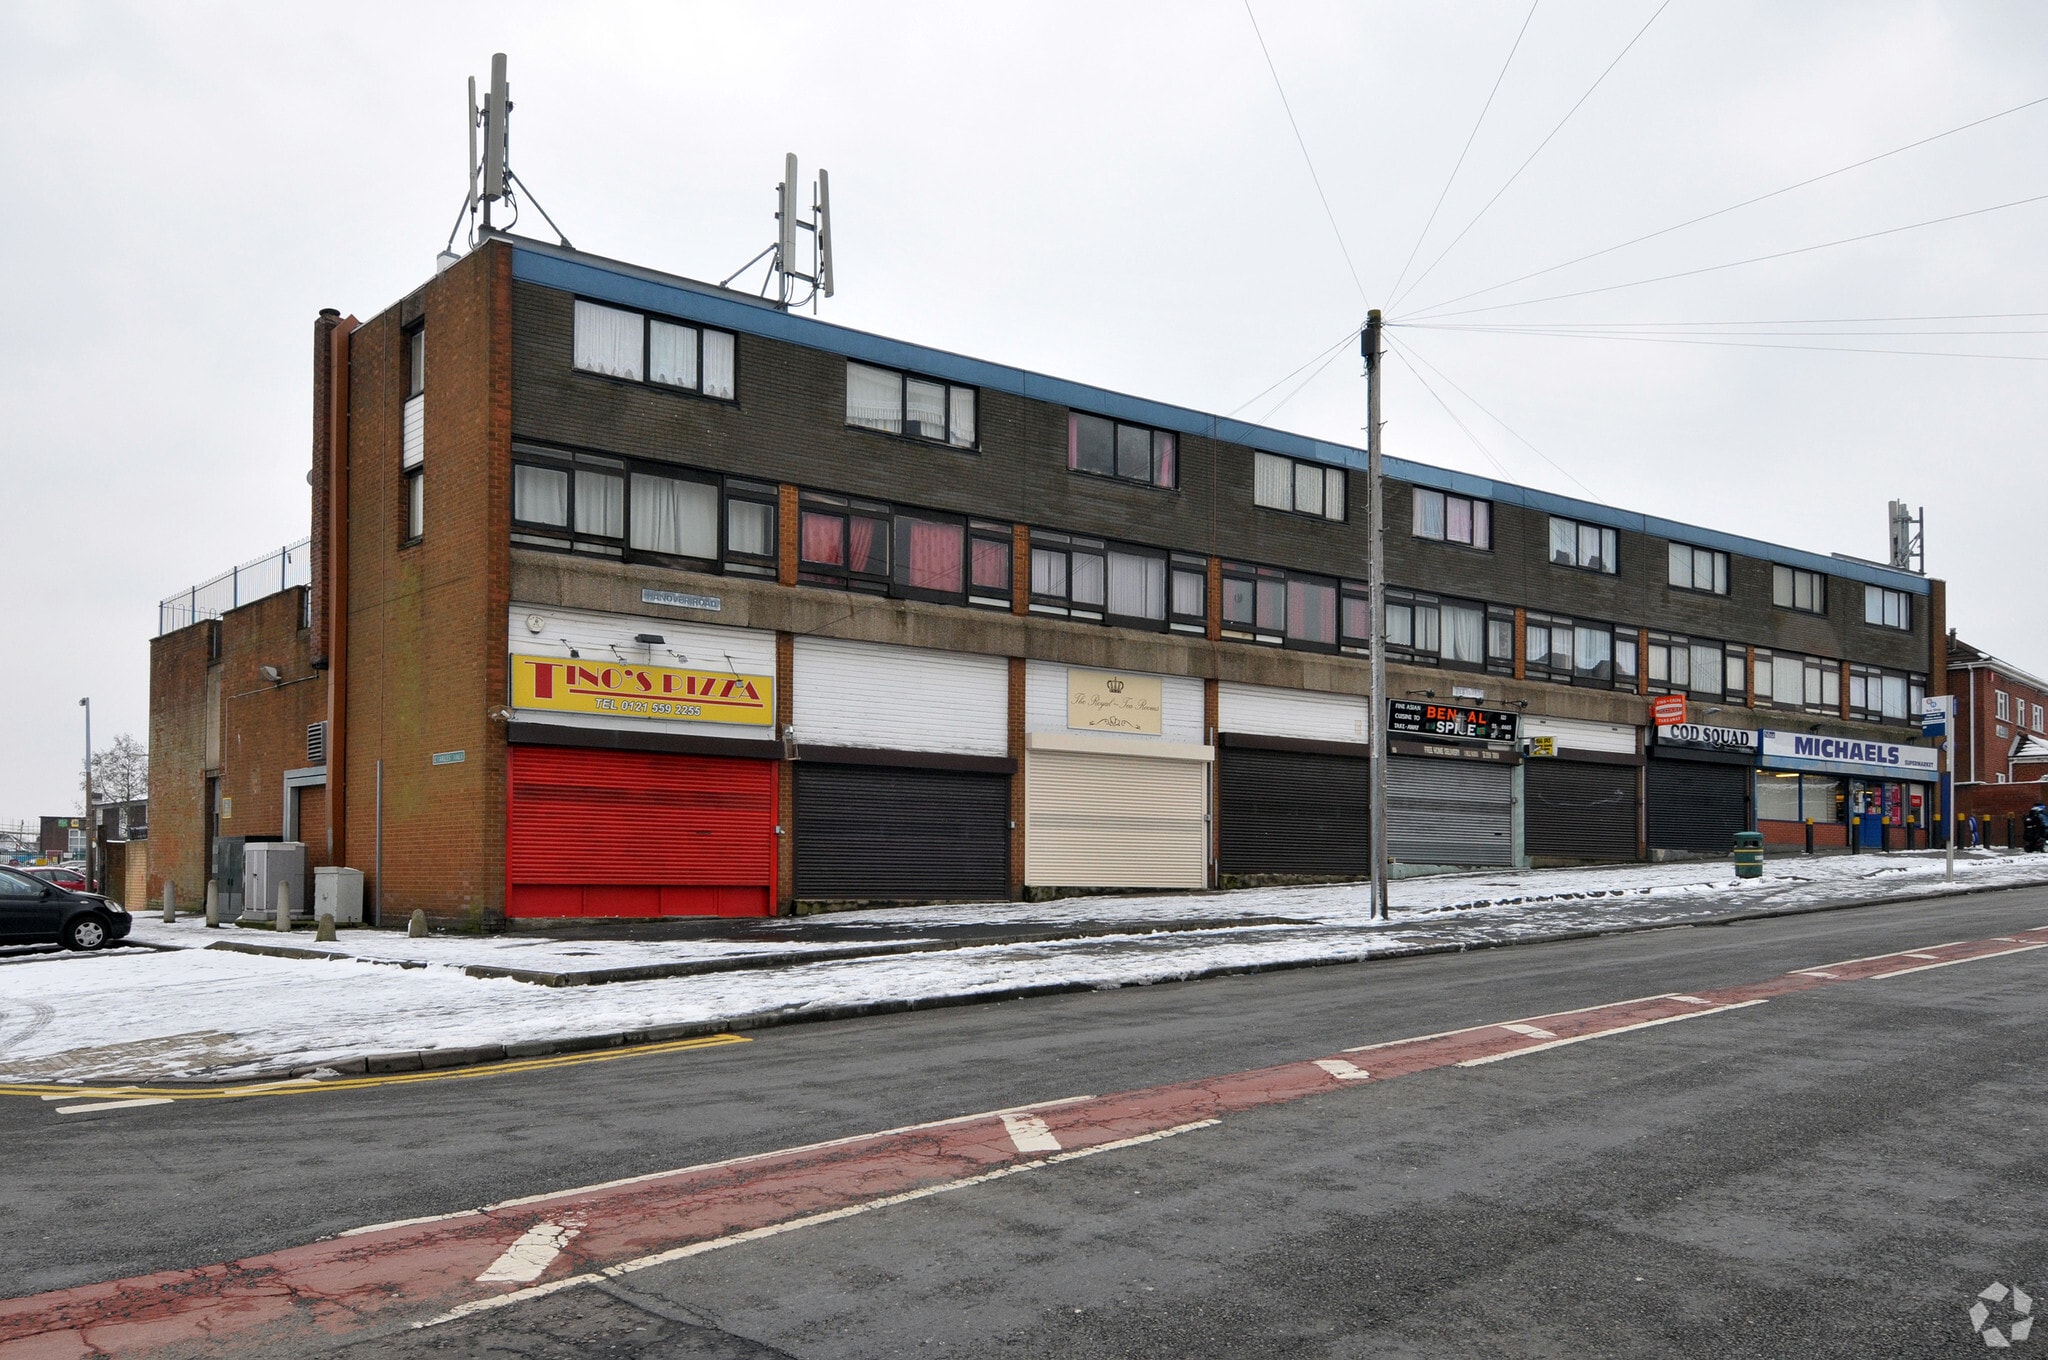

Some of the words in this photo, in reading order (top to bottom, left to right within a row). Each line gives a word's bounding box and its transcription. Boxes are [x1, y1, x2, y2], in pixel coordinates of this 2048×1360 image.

[692, 598, 717, 608] ROAD
[524, 661, 653, 699] TINO'S
[662, 674, 761, 700] PIZZA
[595, 698, 618, 710] TEL
[621, 699, 649, 712] 0121
[651, 703, 672, 714] 559
[675, 704, 702, 716] 2255
[1071, 692, 1086, 705] The
[1087, 694, 1112, 711] Royal
[1120, 697, 1133, 709] Tea
[1135, 699, 1160, 711] Rooms
[1670, 724, 1700, 740] COD
[1702, 727, 1750, 748] SQUAD
[1794, 736, 1900, 765] MICHAELS
[1904, 759, 1935, 768] SUPERMARKET
